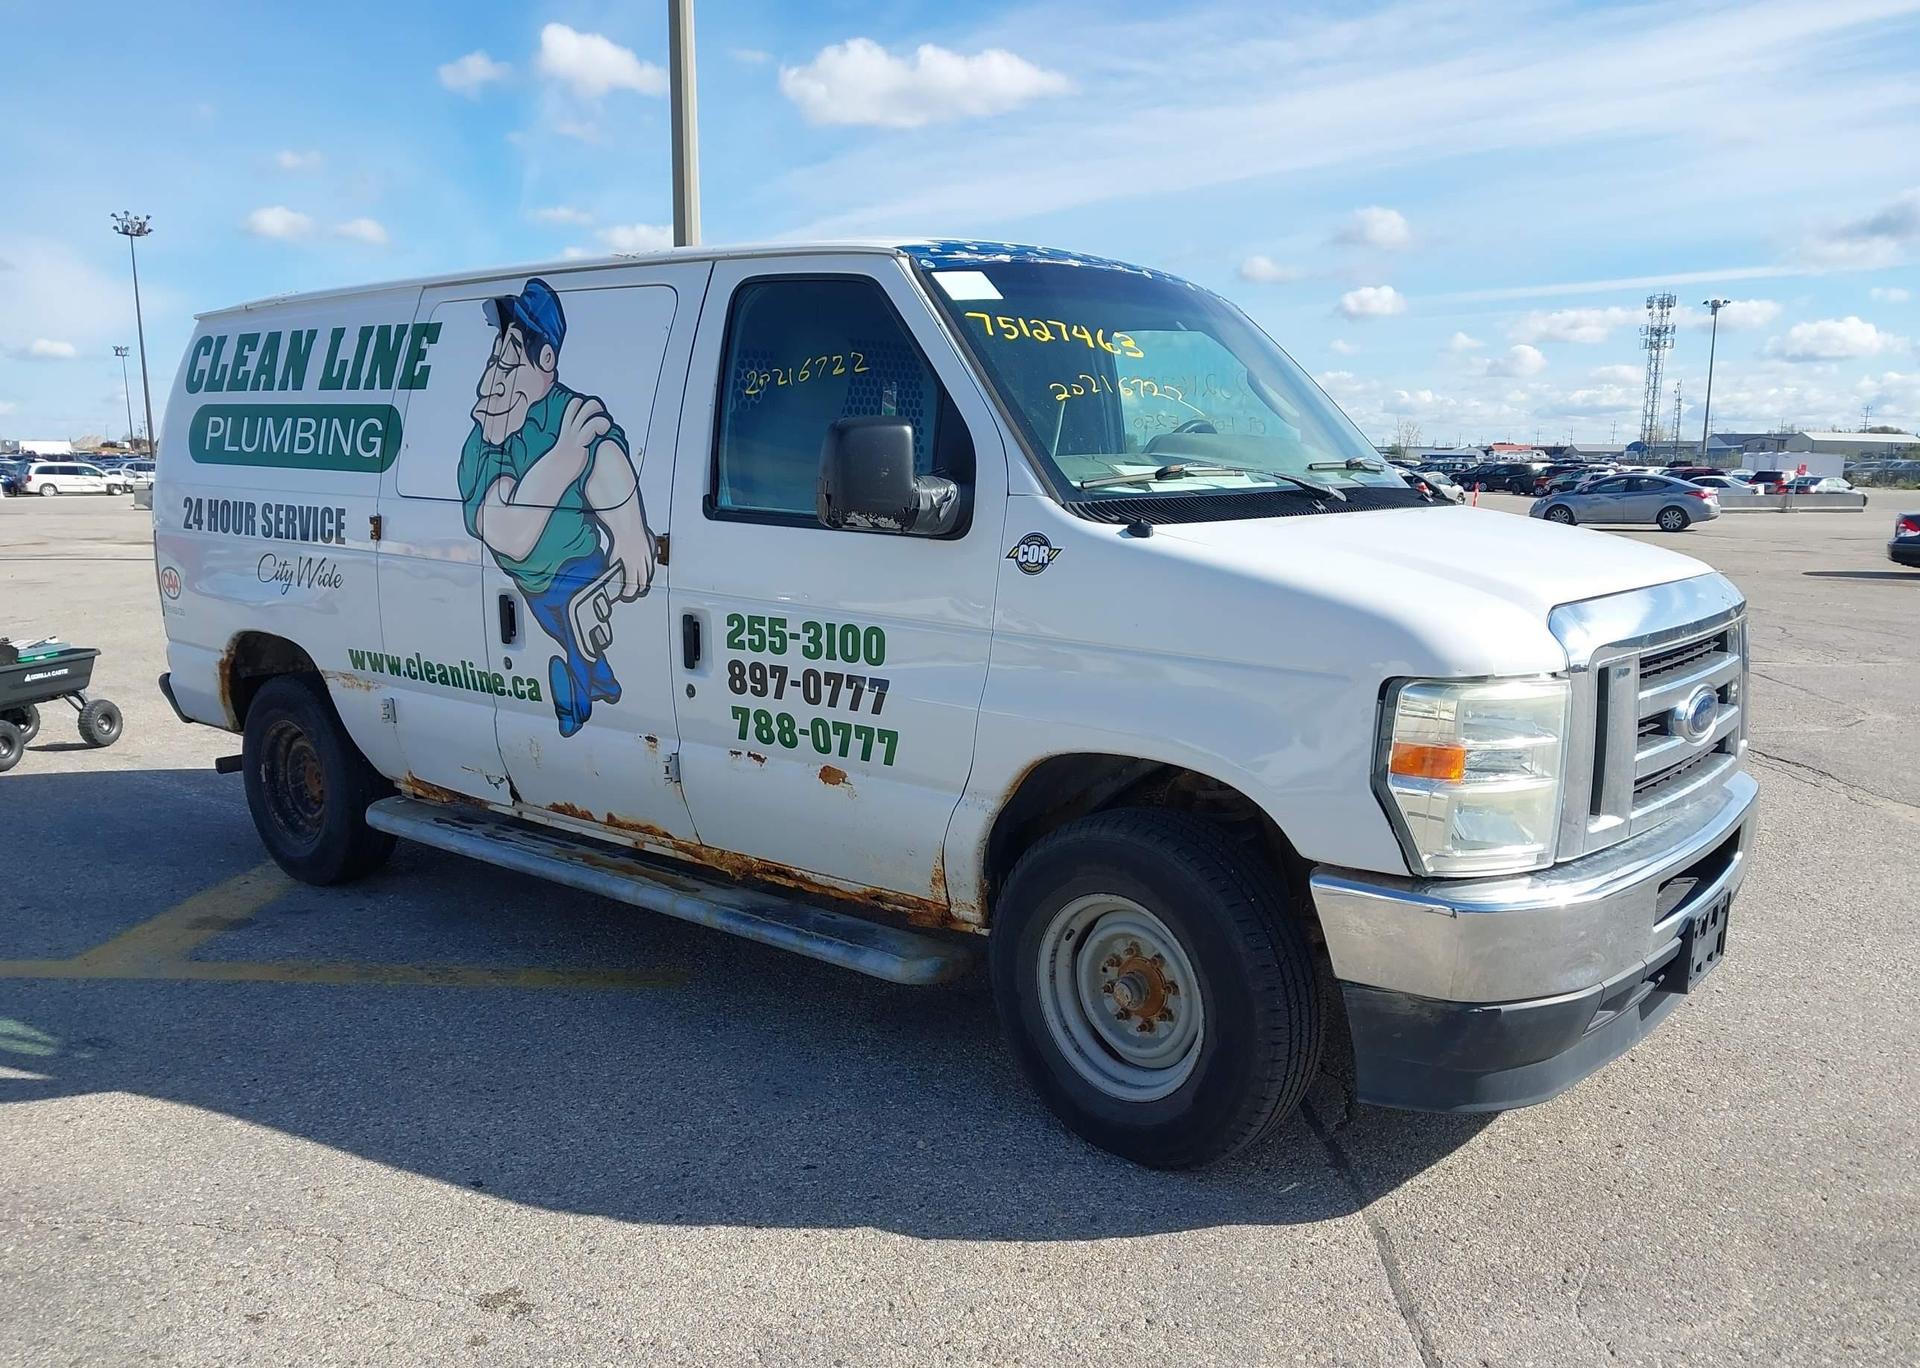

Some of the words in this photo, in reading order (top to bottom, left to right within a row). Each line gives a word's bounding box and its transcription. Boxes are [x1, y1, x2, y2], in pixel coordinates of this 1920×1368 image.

[186, 329, 318, 394] CLEAN
[318, 322, 442, 390] LINE
[964, 311, 1145, 358] 75127463
[744, 351, 871, 395] 20216722
[1049, 374, 1206, 416] 20216722
[204, 416, 383, 458] PLUMBING
[183, 496, 204, 531] 24
[207, 498, 257, 536] HOUR
[261, 502, 346, 545] SERVICE
[257, 553, 294, 596] City
[297, 556, 344, 589] Wide
[1018, 544, 1050, 564] COR
[163, 570, 179, 595] CAA
[726, 613, 886, 667] 255-3100
[348, 648, 543, 702] www.cleanline.ca
[727, 659, 890, 715] 897-0777
[730, 705, 899, 766] 788-0777
